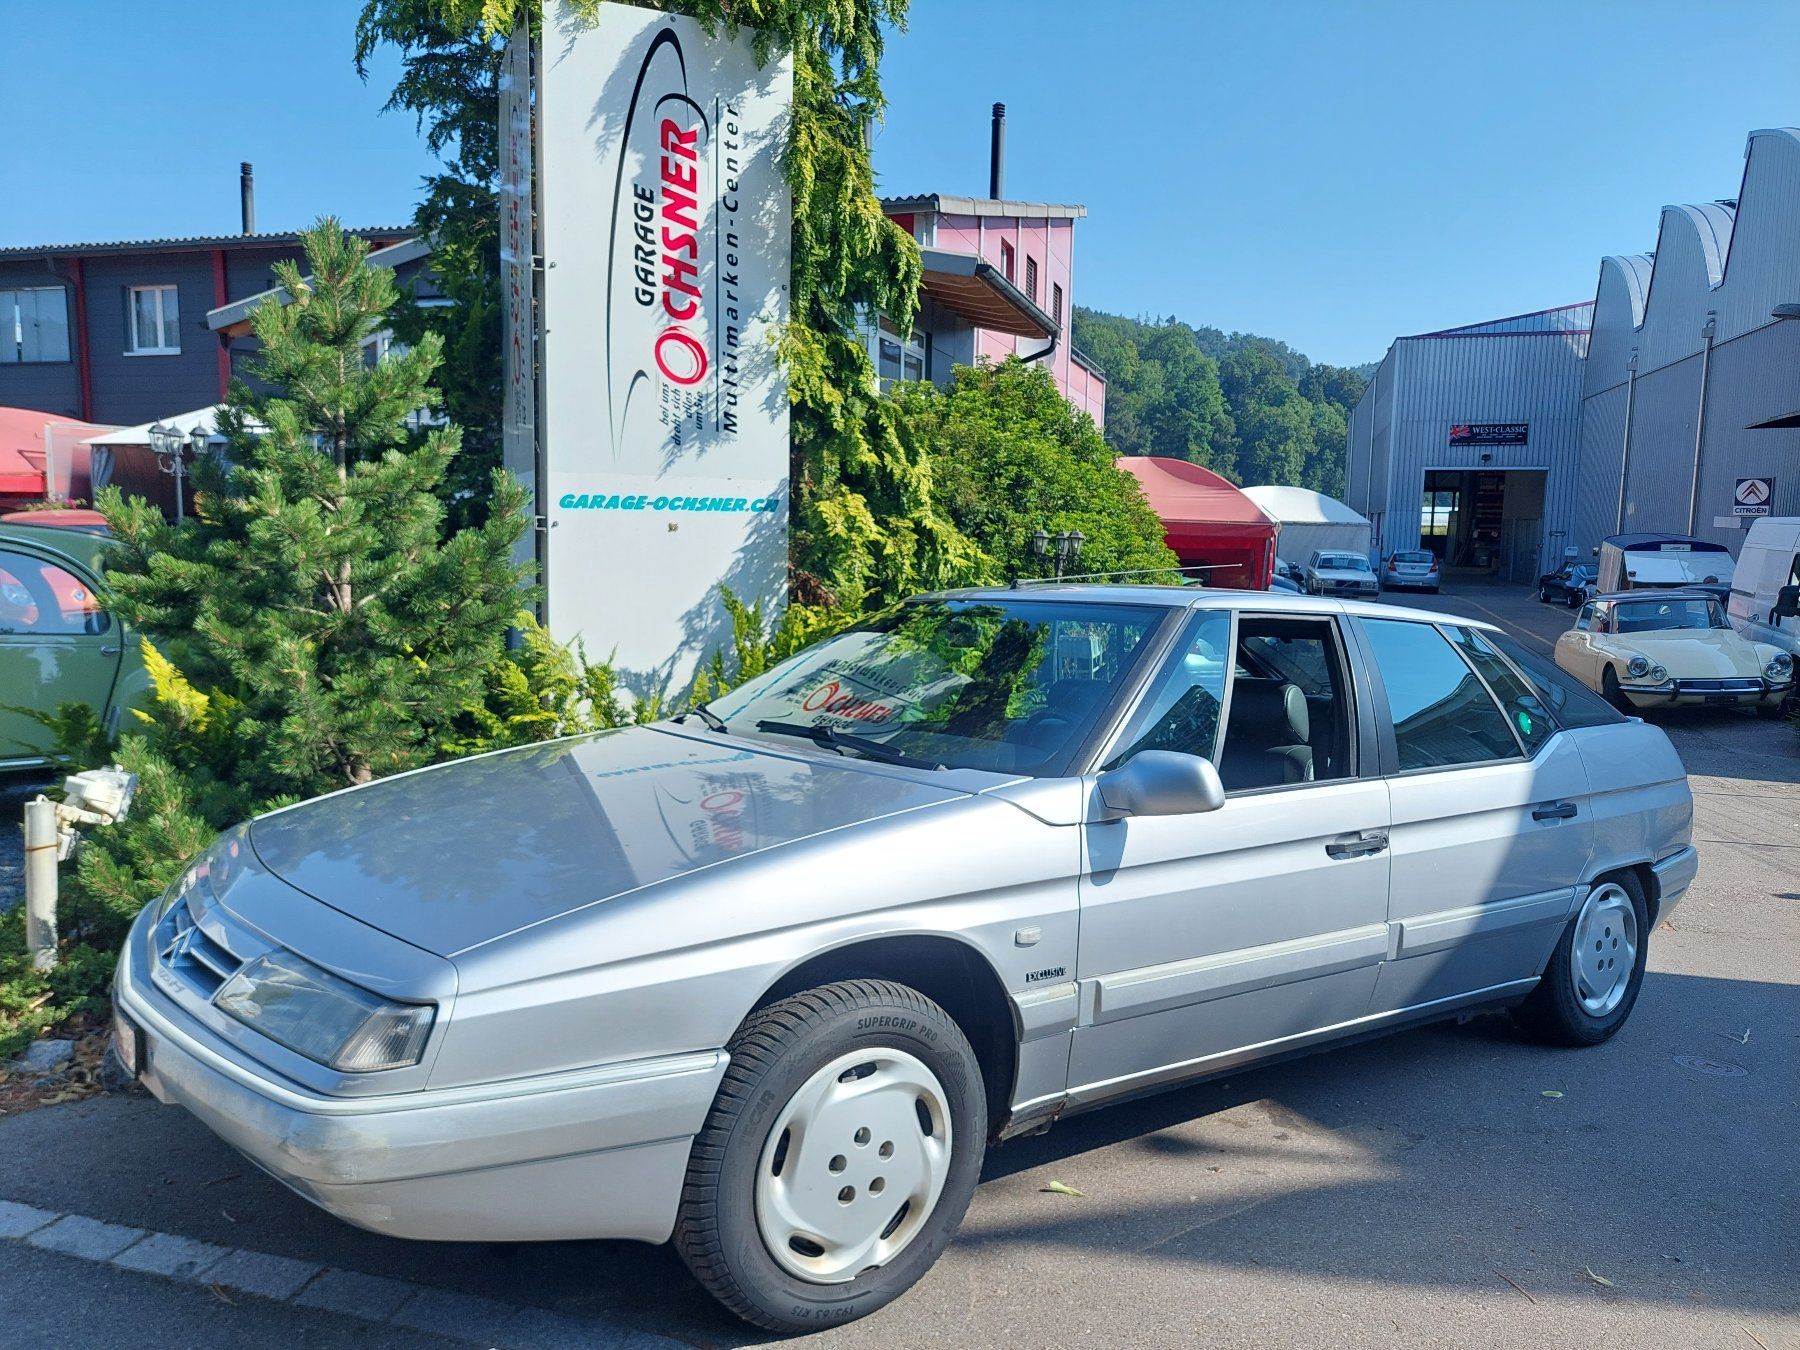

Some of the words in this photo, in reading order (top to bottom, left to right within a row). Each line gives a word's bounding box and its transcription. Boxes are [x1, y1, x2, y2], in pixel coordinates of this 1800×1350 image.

[634, 184, 656, 306] GARAGE
[654, 118, 708, 385] OCHSNER
[722, 103, 739, 435] Multimarken-Center
[661, 382, 669, 404] uns
[671, 388, 681, 411] sich
[694, 391, 703, 410] Sie
[659, 405, 669, 426] bei
[683, 391, 693, 419] alles
[671, 413, 681, 446] dreht
[695, 412, 703, 431] um
[1473, 426, 1528, 434] WEST-CLASSIC
[559, 494, 780, 513] GARAGE-OCHSNER.CH
[1026, 966, 1067, 982] EXCLUSIVE
[857, 1015, 918, 1031] SUPERGRIP
[919, 1025, 938, 1043] PRO
[814, 1305, 854, 1319] 195/65
